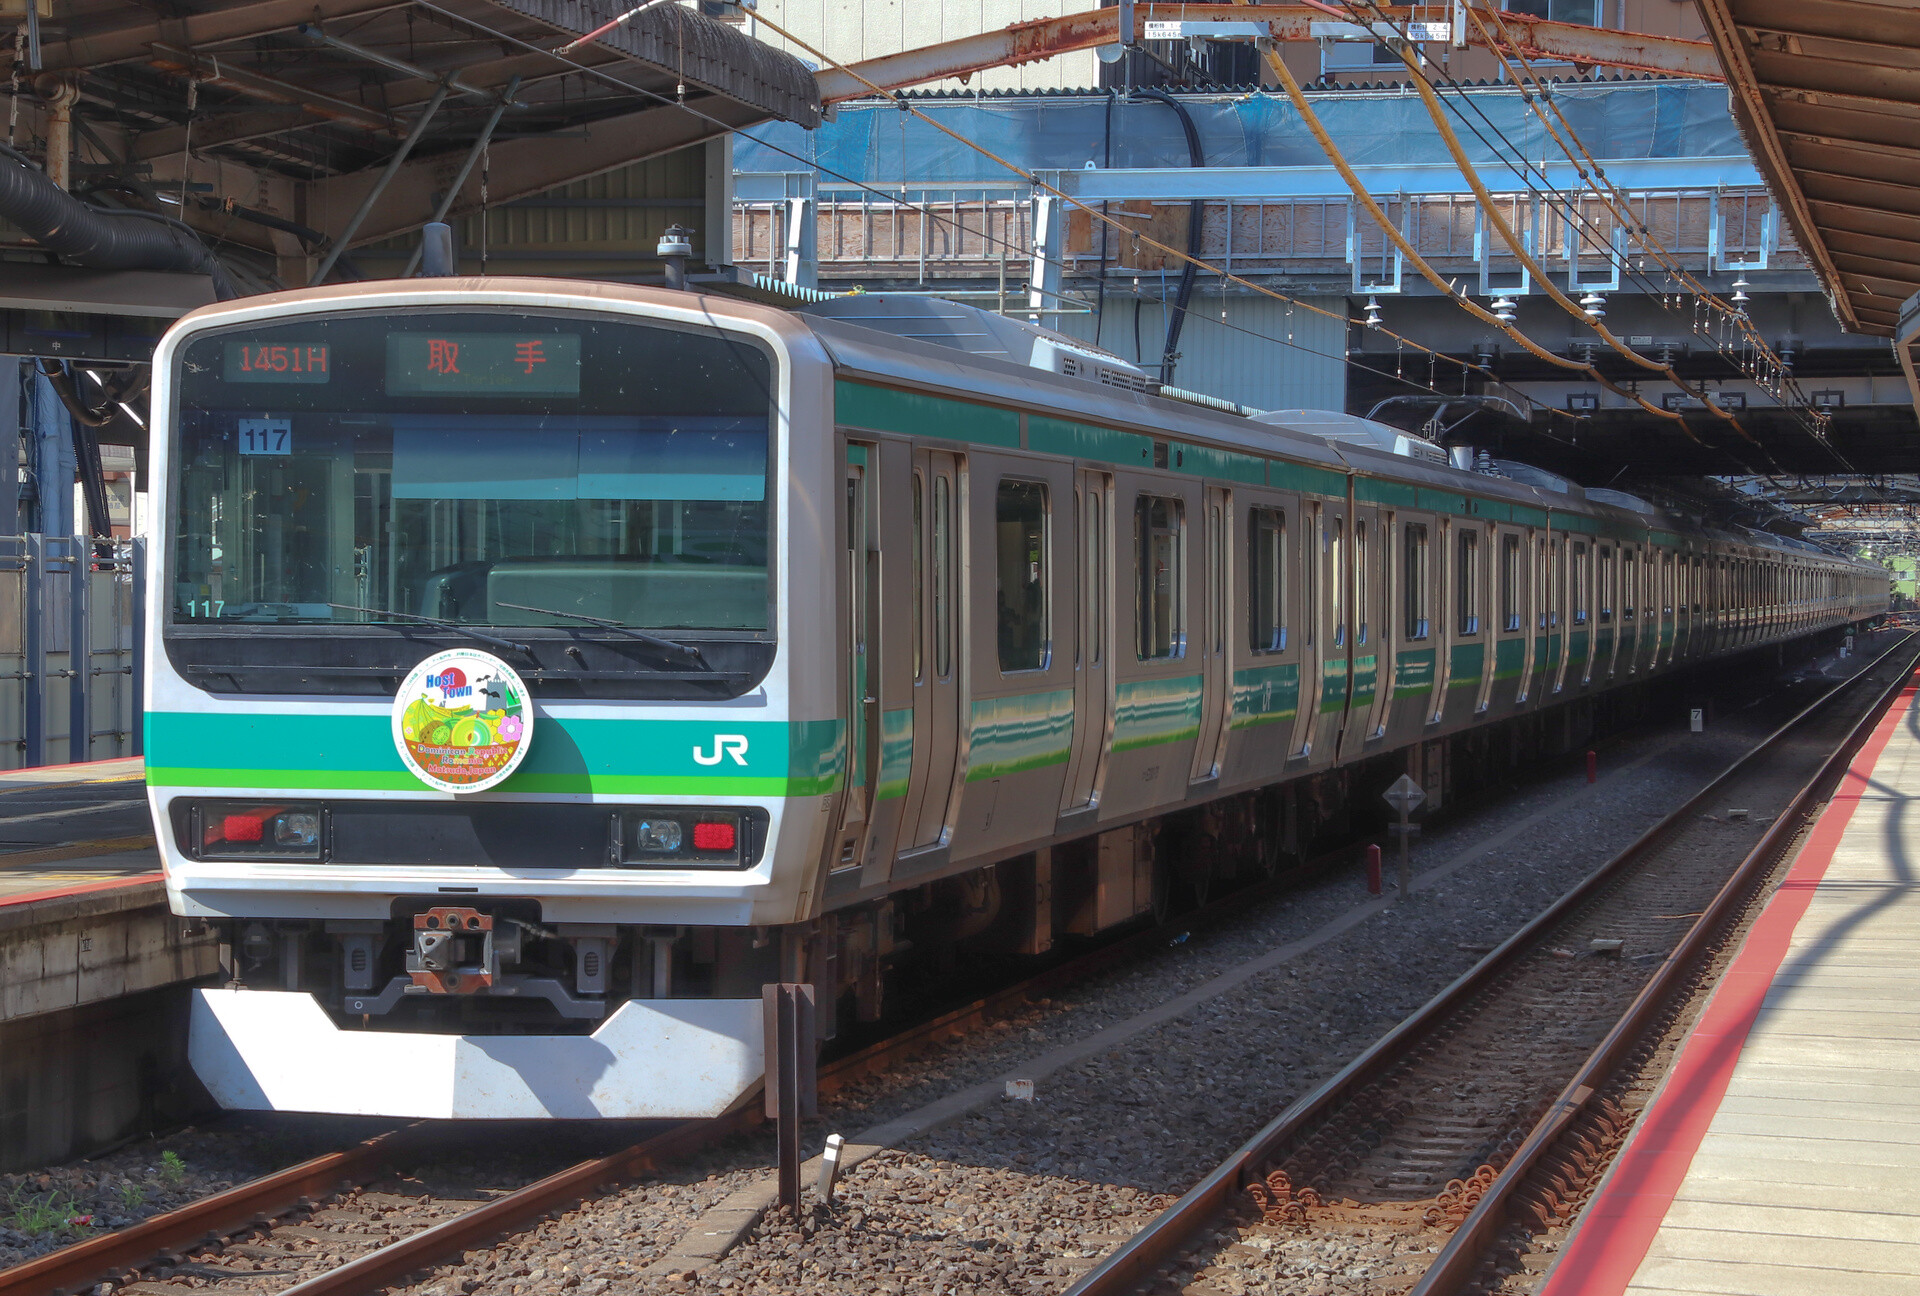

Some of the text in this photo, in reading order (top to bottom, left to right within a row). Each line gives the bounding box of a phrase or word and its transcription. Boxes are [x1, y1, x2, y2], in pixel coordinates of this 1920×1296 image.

[241, 346, 327, 373] 1451H
[427, 339, 547, 374] 取手
[245, 428, 288, 451] 117
[187, 600, 225, 618] 117
[426, 672, 455, 688] Host
[443, 685, 472, 699] Town
[1692, 710, 1701, 719] 7
[418, 744, 508, 757] Dominican Republic
[693, 734, 749, 766] JR
[442, 756, 484, 765] Romania
